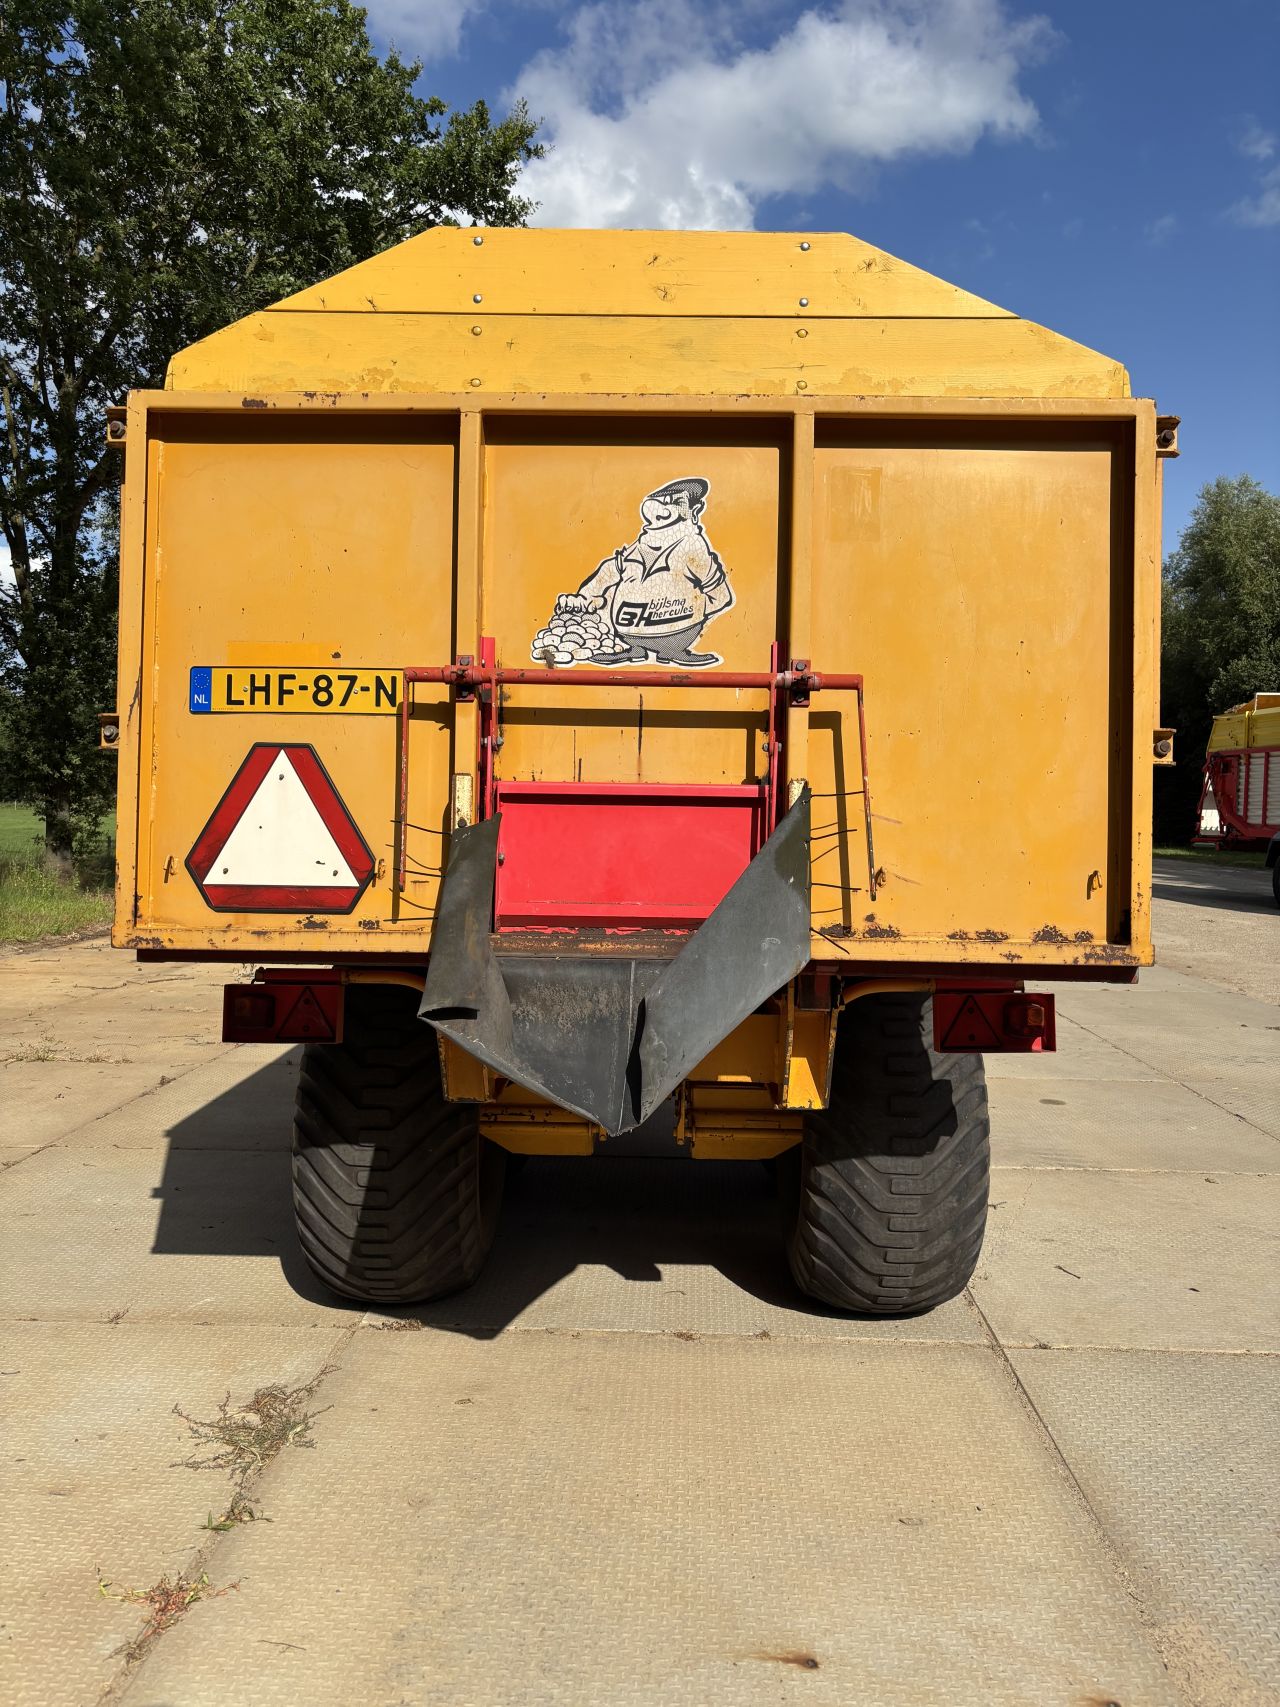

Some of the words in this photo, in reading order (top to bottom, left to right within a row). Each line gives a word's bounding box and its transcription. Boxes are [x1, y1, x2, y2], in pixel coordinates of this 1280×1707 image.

[649, 596, 686, 611] bijlsma
[652, 604, 694, 619] hercules
[226, 673, 397, 707] LHF-87-N
[194, 694, 208, 704] NL
